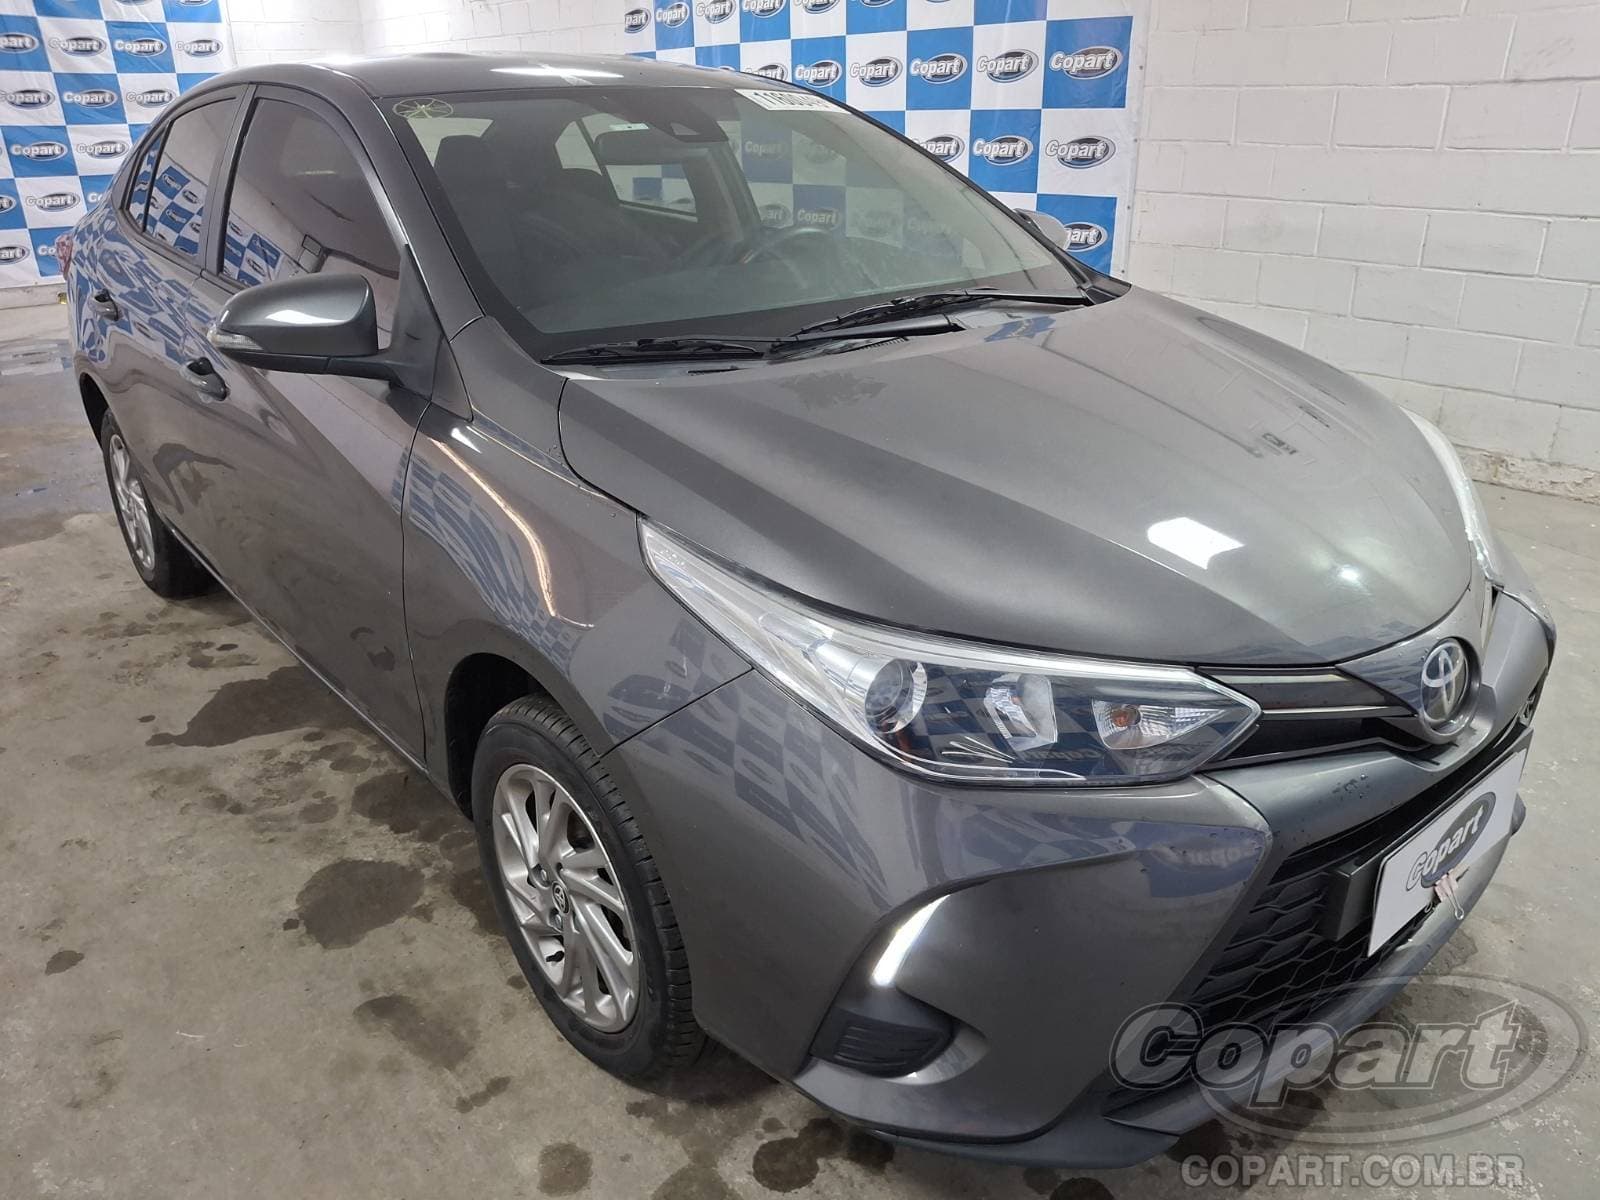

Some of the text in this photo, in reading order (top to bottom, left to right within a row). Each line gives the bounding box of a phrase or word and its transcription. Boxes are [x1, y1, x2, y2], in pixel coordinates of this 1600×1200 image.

[656, 6, 685, 24] Copart
[696, 1, 731, 17] Copart
[625, 13, 645, 27] part
[0, 36, 31, 49] part
[49, 38, 99, 51] Copart
[115, 40, 162, 52] Copart
[176, 40, 217, 53] Copart
[850, 58, 895, 79] Copart
[910, 57, 961, 79] Copart
[977, 52, 1031, 78] Copart
[1050, 47, 1119, 77] Copart
[795, 64, 837, 83] Copart
[63, 92, 112, 105] Copart
[126, 92, 171, 106] Copart
[10, 144, 62, 158] Copart
[76, 143, 122, 157] Copart
[973, 140, 1026, 162] Copart
[1046, 138, 1107, 165] Copart
[26, 195, 73, 209] Copart
[1405, 804, 1484, 891] Copart
